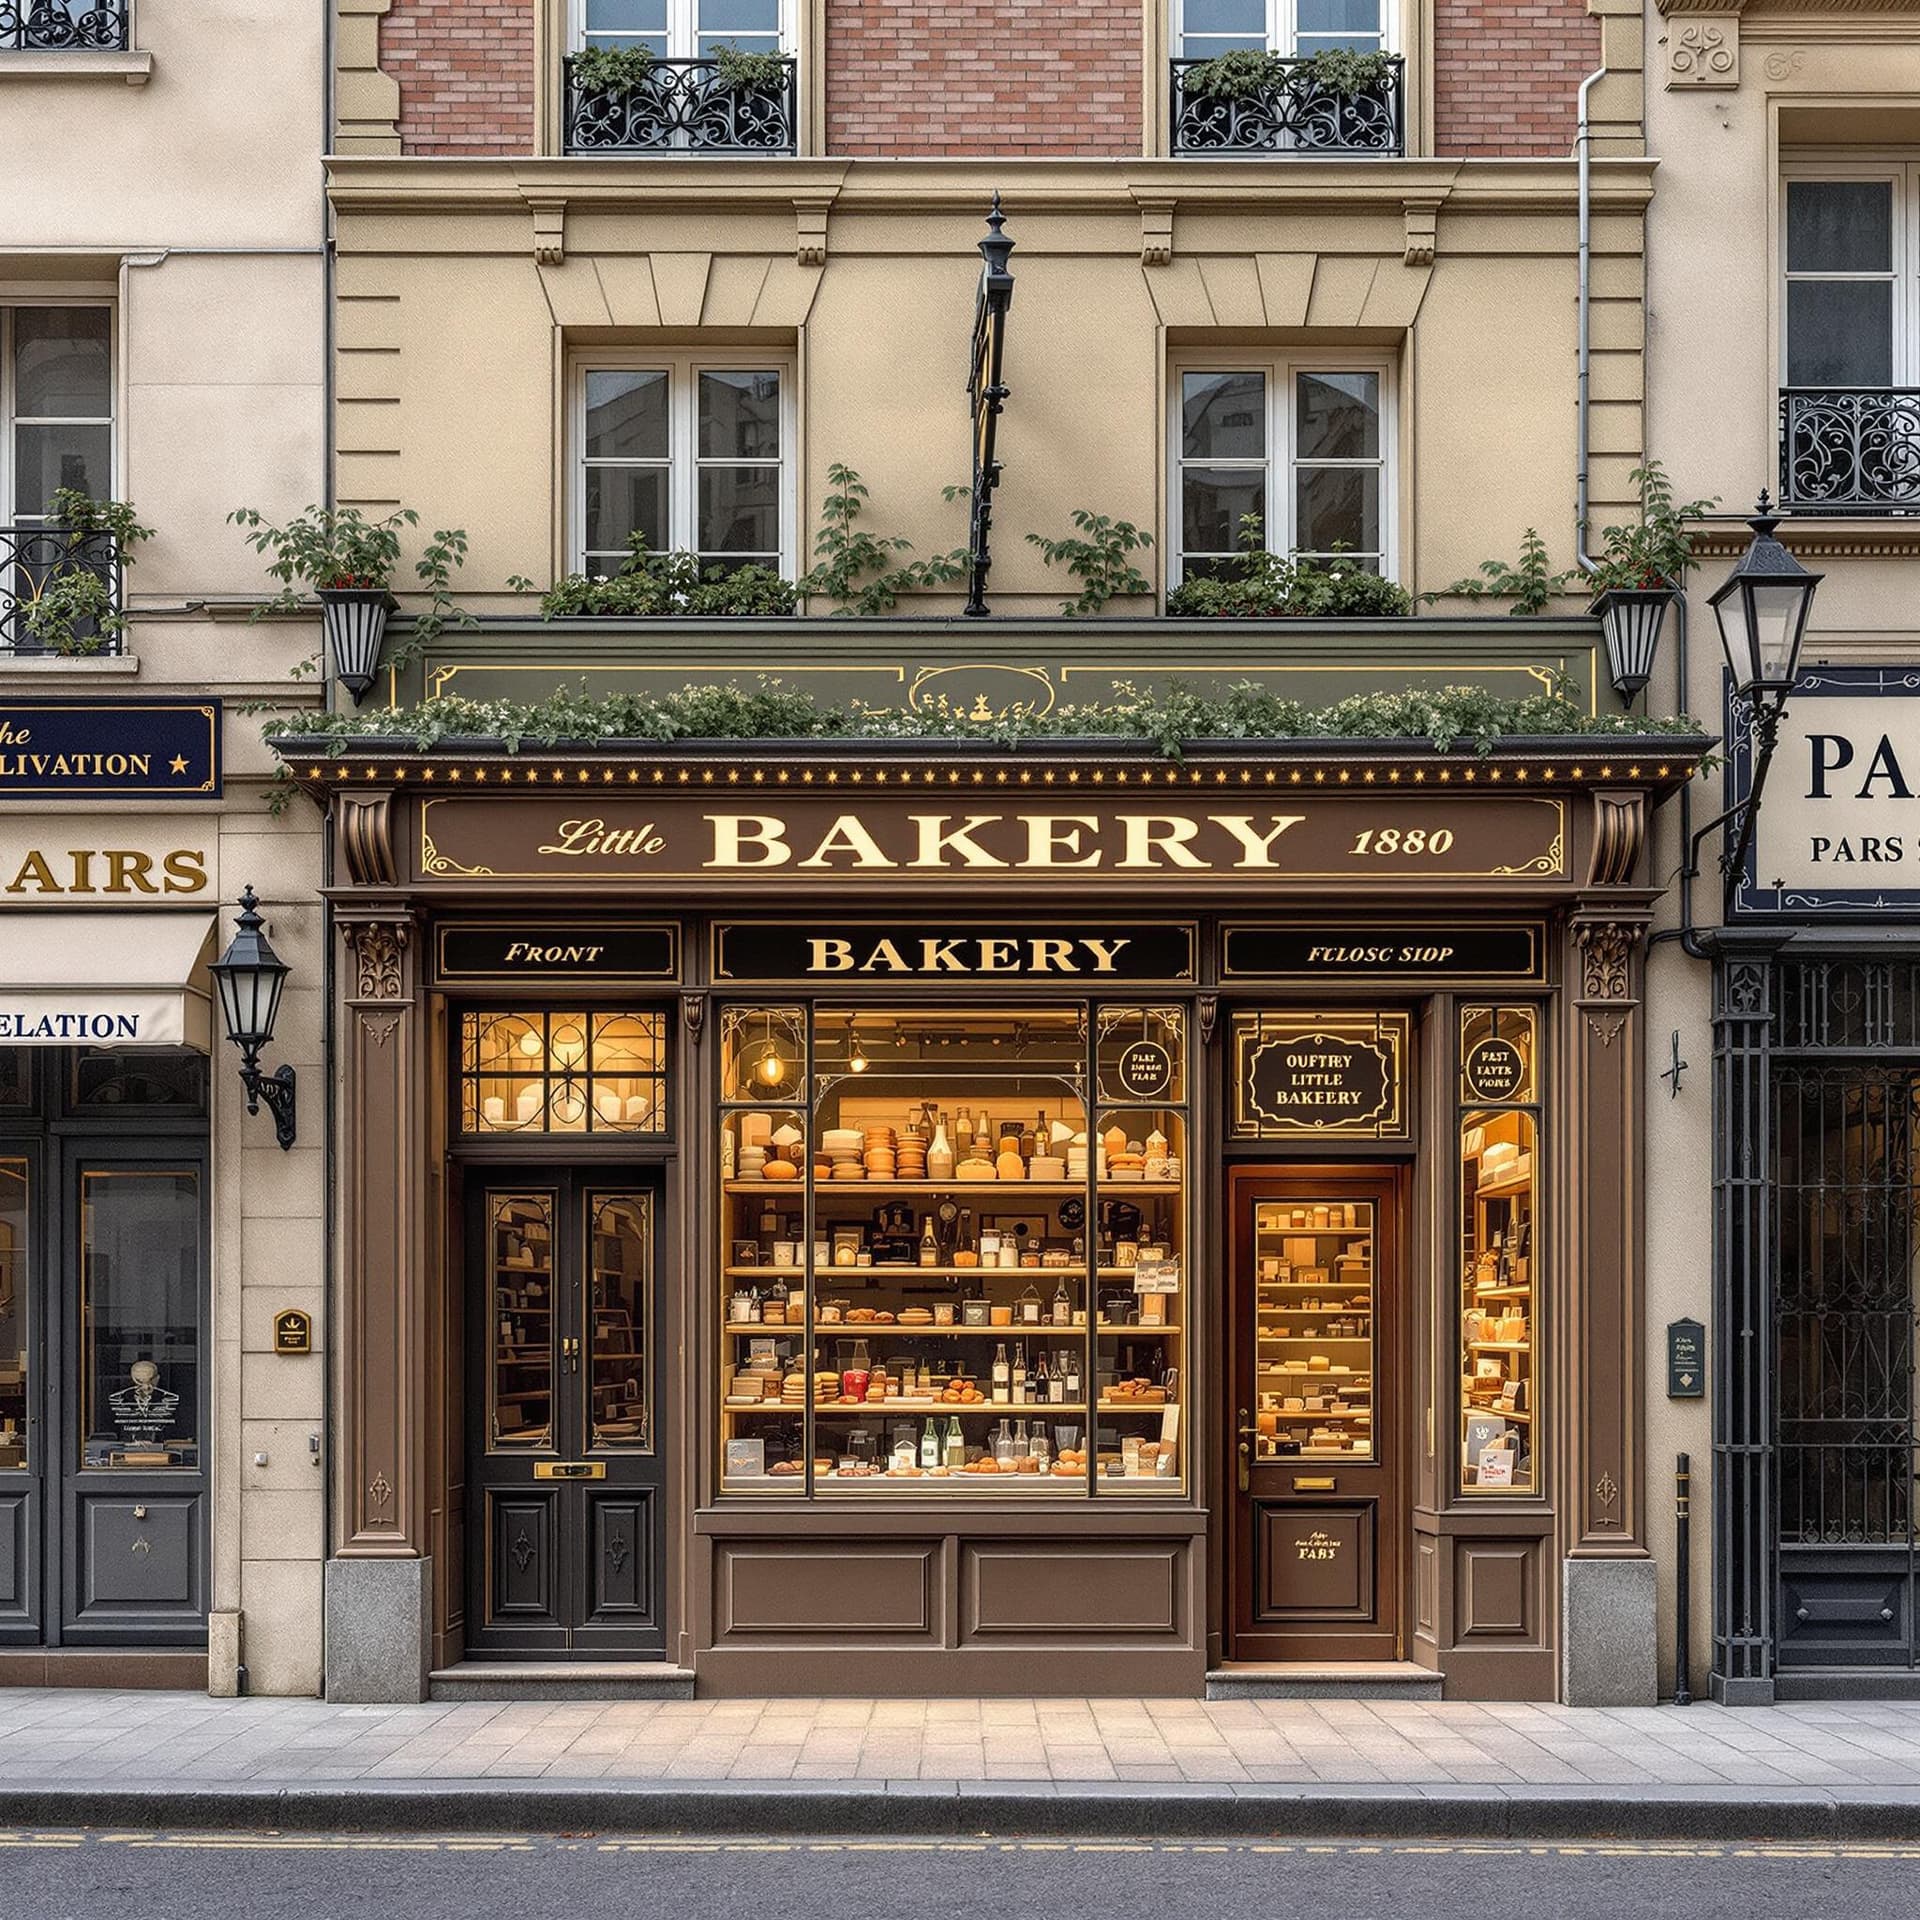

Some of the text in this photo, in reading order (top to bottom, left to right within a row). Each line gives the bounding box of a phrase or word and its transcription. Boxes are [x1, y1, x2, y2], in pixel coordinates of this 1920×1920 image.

[0, 754, 151, 776] LIVATION
[1804, 733, 1920, 799] PA
[538, 815, 1454, 868] Little BAKERY 1880
[1810, 836, 1903, 862] PARS
[4, 849, 208, 894] AIRS
[503, 942, 604, 962] FRONT
[806, 938, 1131, 972] BAKERY
[0, 1014, 140, 1039] ELATION
